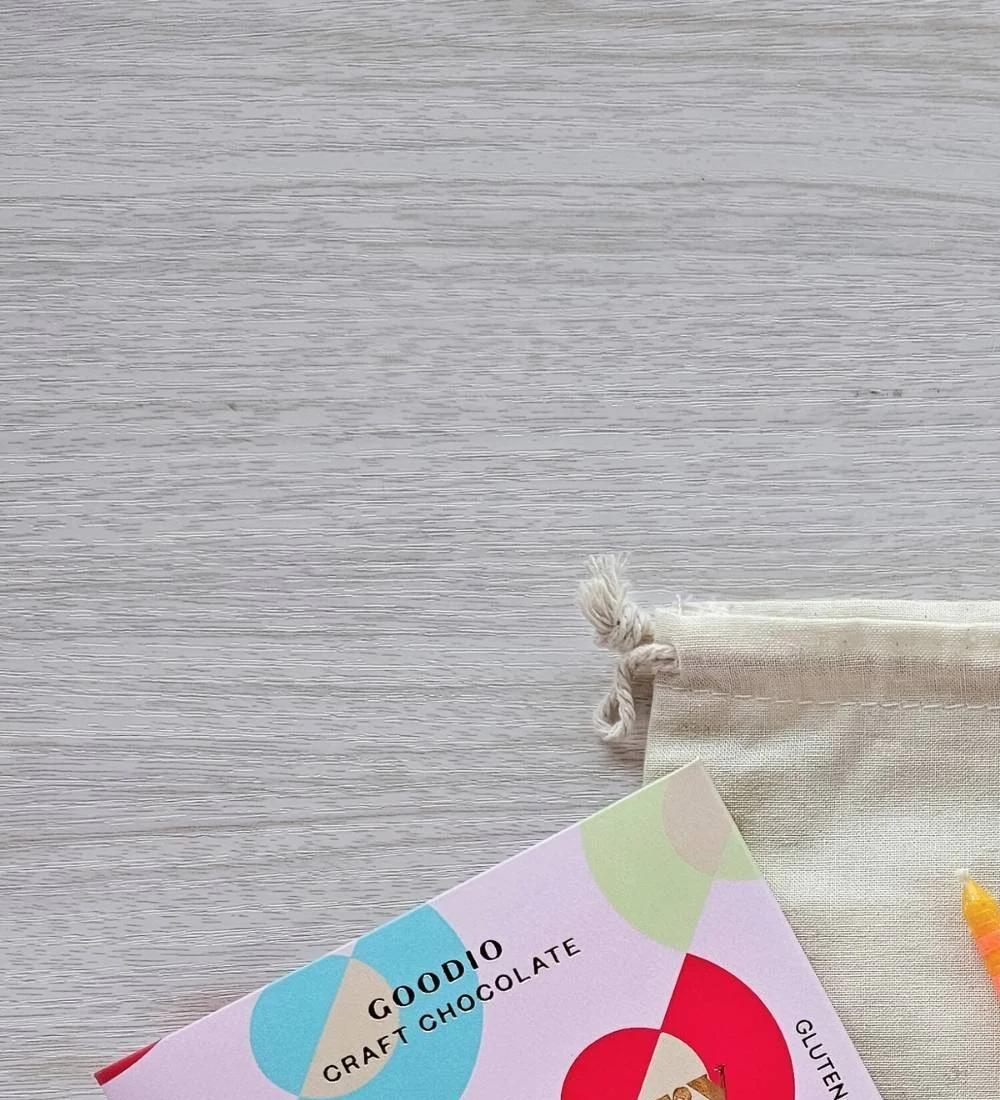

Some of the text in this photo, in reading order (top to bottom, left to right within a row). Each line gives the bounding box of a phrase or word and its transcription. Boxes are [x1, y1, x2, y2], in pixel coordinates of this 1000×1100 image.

[323, 938, 581, 1084] CRAFT CHOCOLATE
[368, 939, 503, 1022] GOODIO
